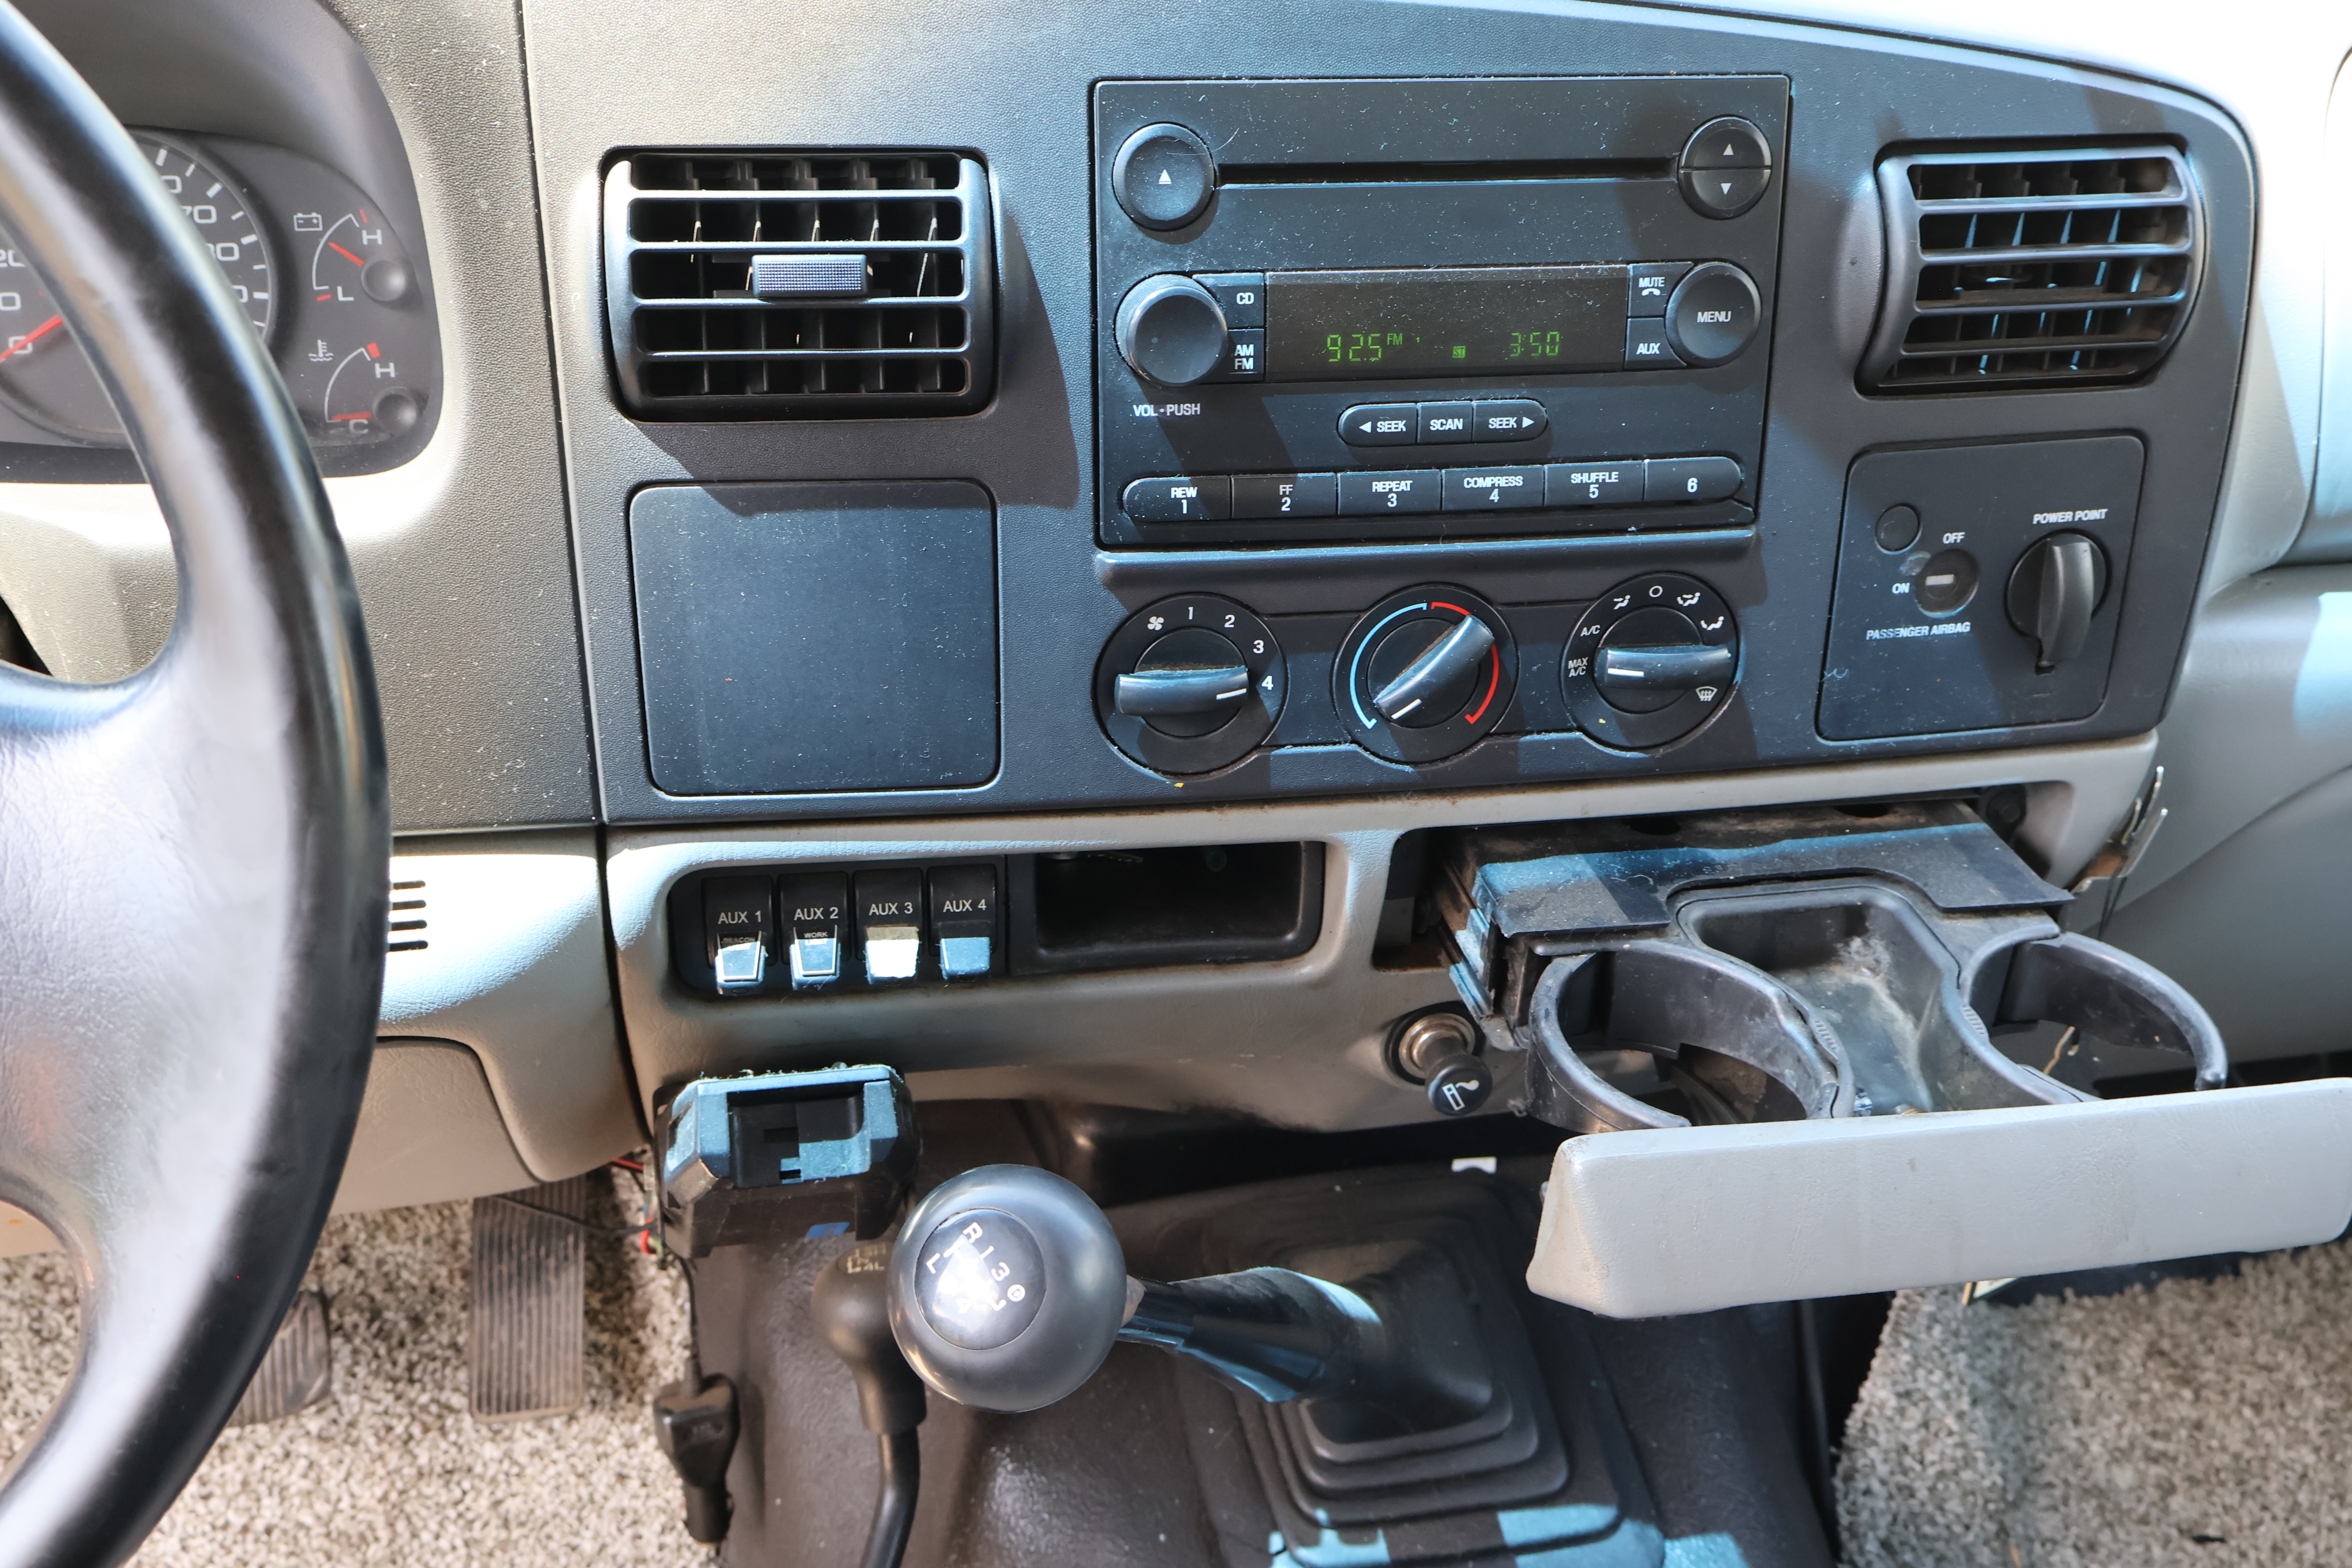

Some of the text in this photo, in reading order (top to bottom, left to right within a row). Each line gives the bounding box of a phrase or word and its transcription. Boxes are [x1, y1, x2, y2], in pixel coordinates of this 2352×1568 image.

[362, 229, 382, 245] H
[1639, 277, 1664, 288] MUTE
[337, 286, 354, 301] L
[1236, 292, 1254, 305] CD
[1697, 311, 1731, 323] MENU
[1387, 333, 1403, 345] FM
[1510, 332, 1560, 356] 3:50
[1234, 344, 1254, 356] AM
[1636, 343, 1661, 354] AUX
[375, 362, 396, 378] H
[1235, 358, 1254, 370] FM
[349, 419, 369, 434] C
[1377, 420, 1406, 432] SEEK
[1430, 419, 1463, 430] SCAN
[1488, 417, 1517, 428] SEEK
[1464, 476, 1523, 488] COMPRESS
[1571, 472, 1619, 484] SHUFFLE
[1279, 485, 1294, 495] FF
[1372, 481, 1413, 492] REPEAT
[1589, 484, 1599, 499] 5
[1687, 477, 1698, 493] 6
[1171, 487, 1198, 498] REW
[1489, 488, 1499, 503] 4
[1281, 497, 1291, 511] 2
[1387, 493, 1397, 507] 3
[1181, 500, 1188, 514] 1
[2033, 509, 2108, 524] POWER POINT
[1942, 532, 1965, 544] OFF
[1892, 583, 1910, 594] ON
[1188, 607, 1193, 620] 1
[1224, 614, 1235, 628] 2
[1580, 624, 1601, 637] A/C
[1866, 622, 1971, 640] PASSENGER AIRBAG
[1253, 640, 1264, 654] 3
[1568, 657, 1588, 669] MAX
[1568, 666, 1586, 677] A/C
[1261, 675, 1274, 690] 4
[869, 902, 913, 916] AUX 3
[943, 898, 987, 913] AUX 4
[718, 910, 761, 924] AUX 1
[794, 907, 839, 921] AUX 2
[963, 1222, 983, 1243] R
[991, 1262, 1010, 1281] 3
